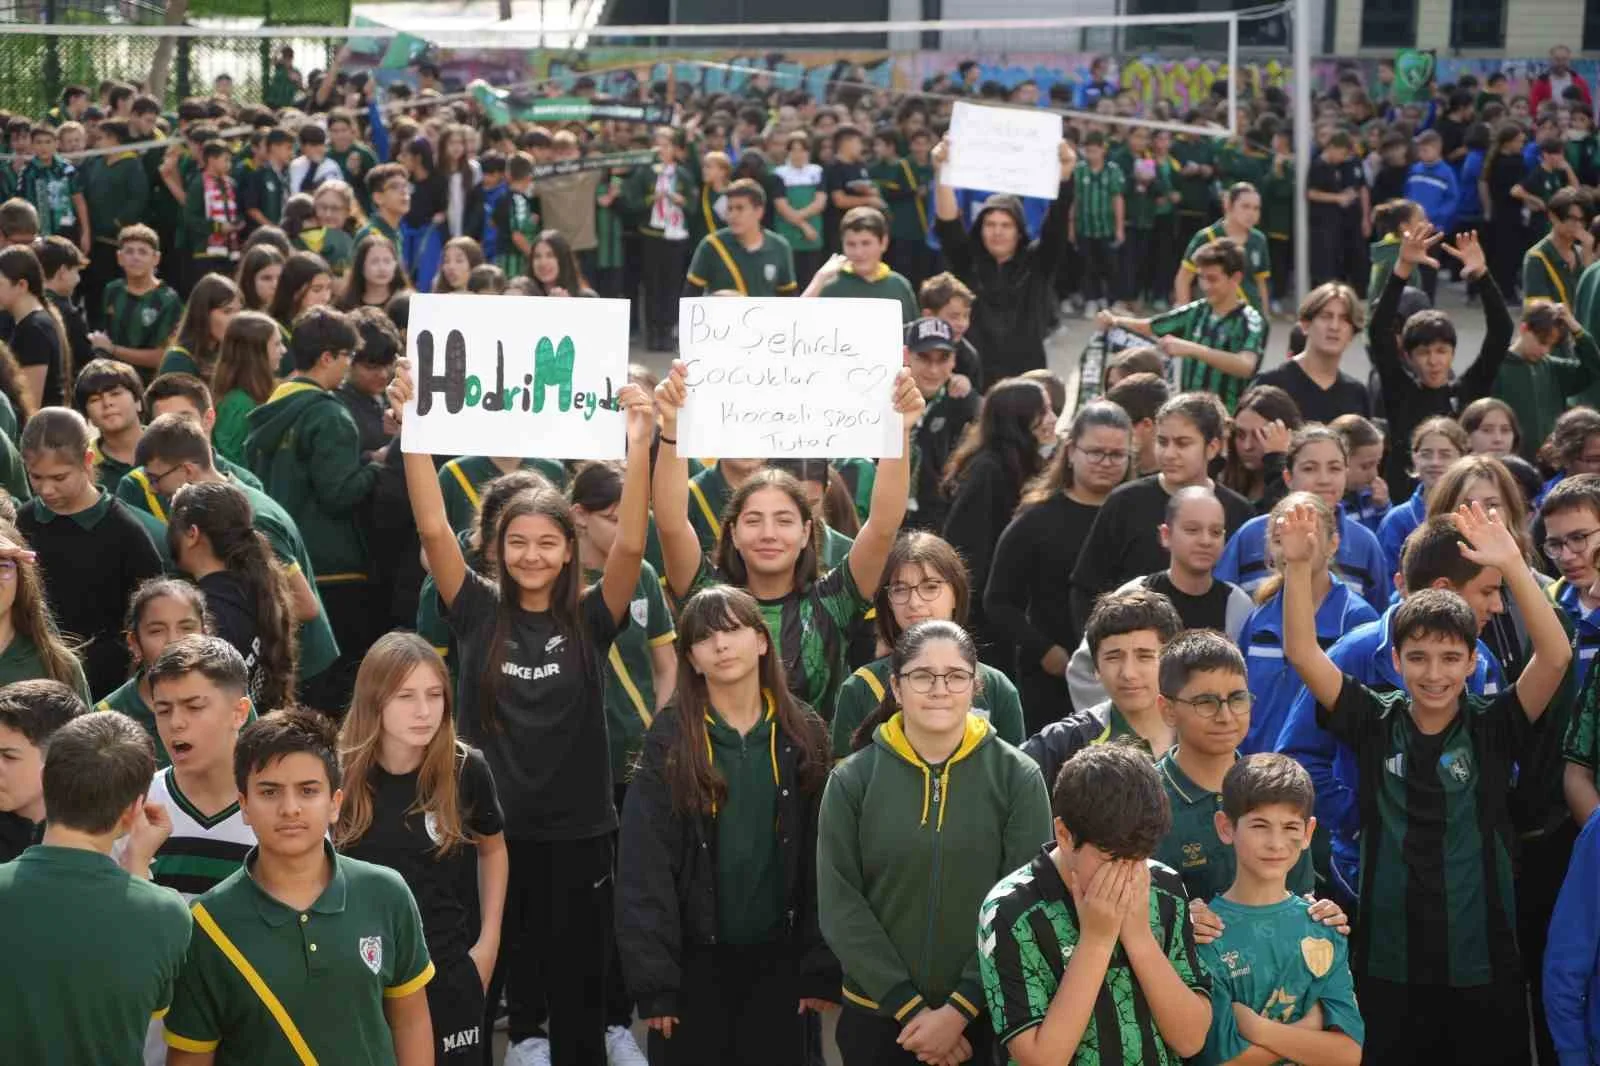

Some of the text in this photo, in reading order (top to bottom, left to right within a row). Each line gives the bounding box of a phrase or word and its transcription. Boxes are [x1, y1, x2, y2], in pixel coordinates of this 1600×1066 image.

[689, 303, 731, 344] Bu
[760, 432, 838, 452] Tutar
[533, 663, 560, 680] AIR
